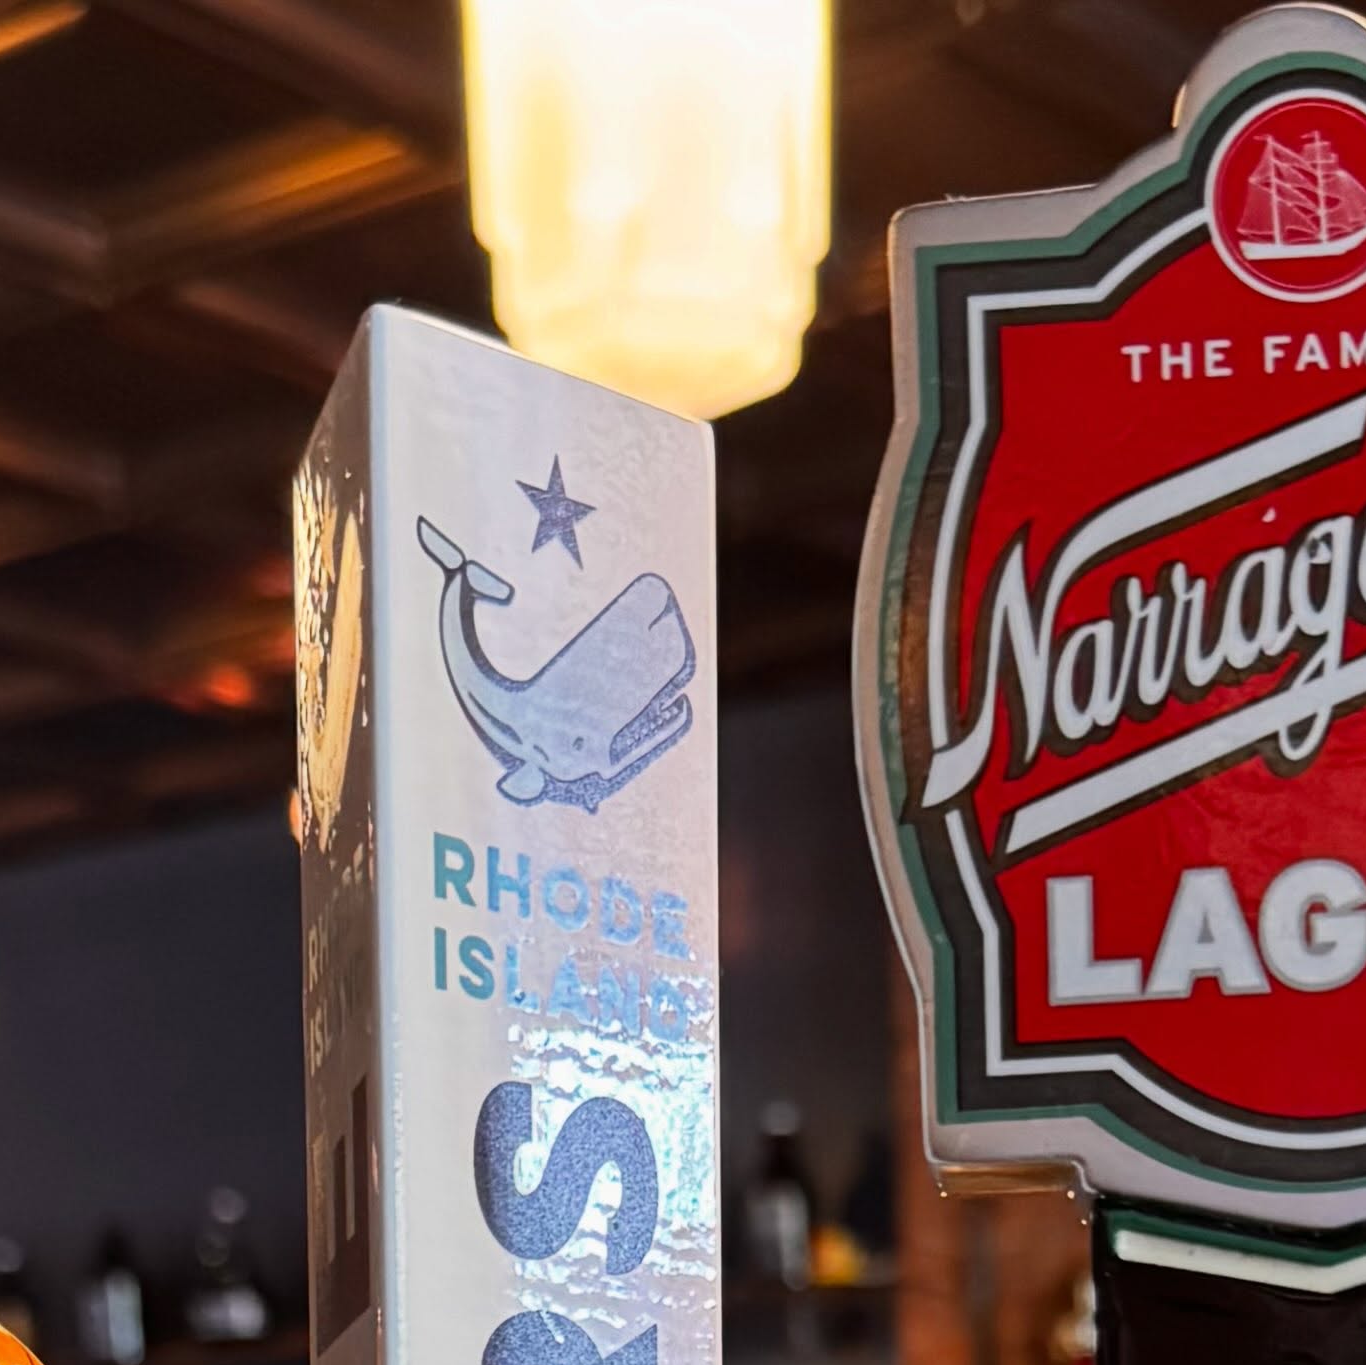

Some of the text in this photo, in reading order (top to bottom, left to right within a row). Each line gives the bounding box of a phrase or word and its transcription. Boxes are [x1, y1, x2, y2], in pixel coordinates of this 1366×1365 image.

[1121, 339, 1234, 383] THE
[433, 830, 693, 962] RHODE
[433, 925, 693, 1044] ISLAND
